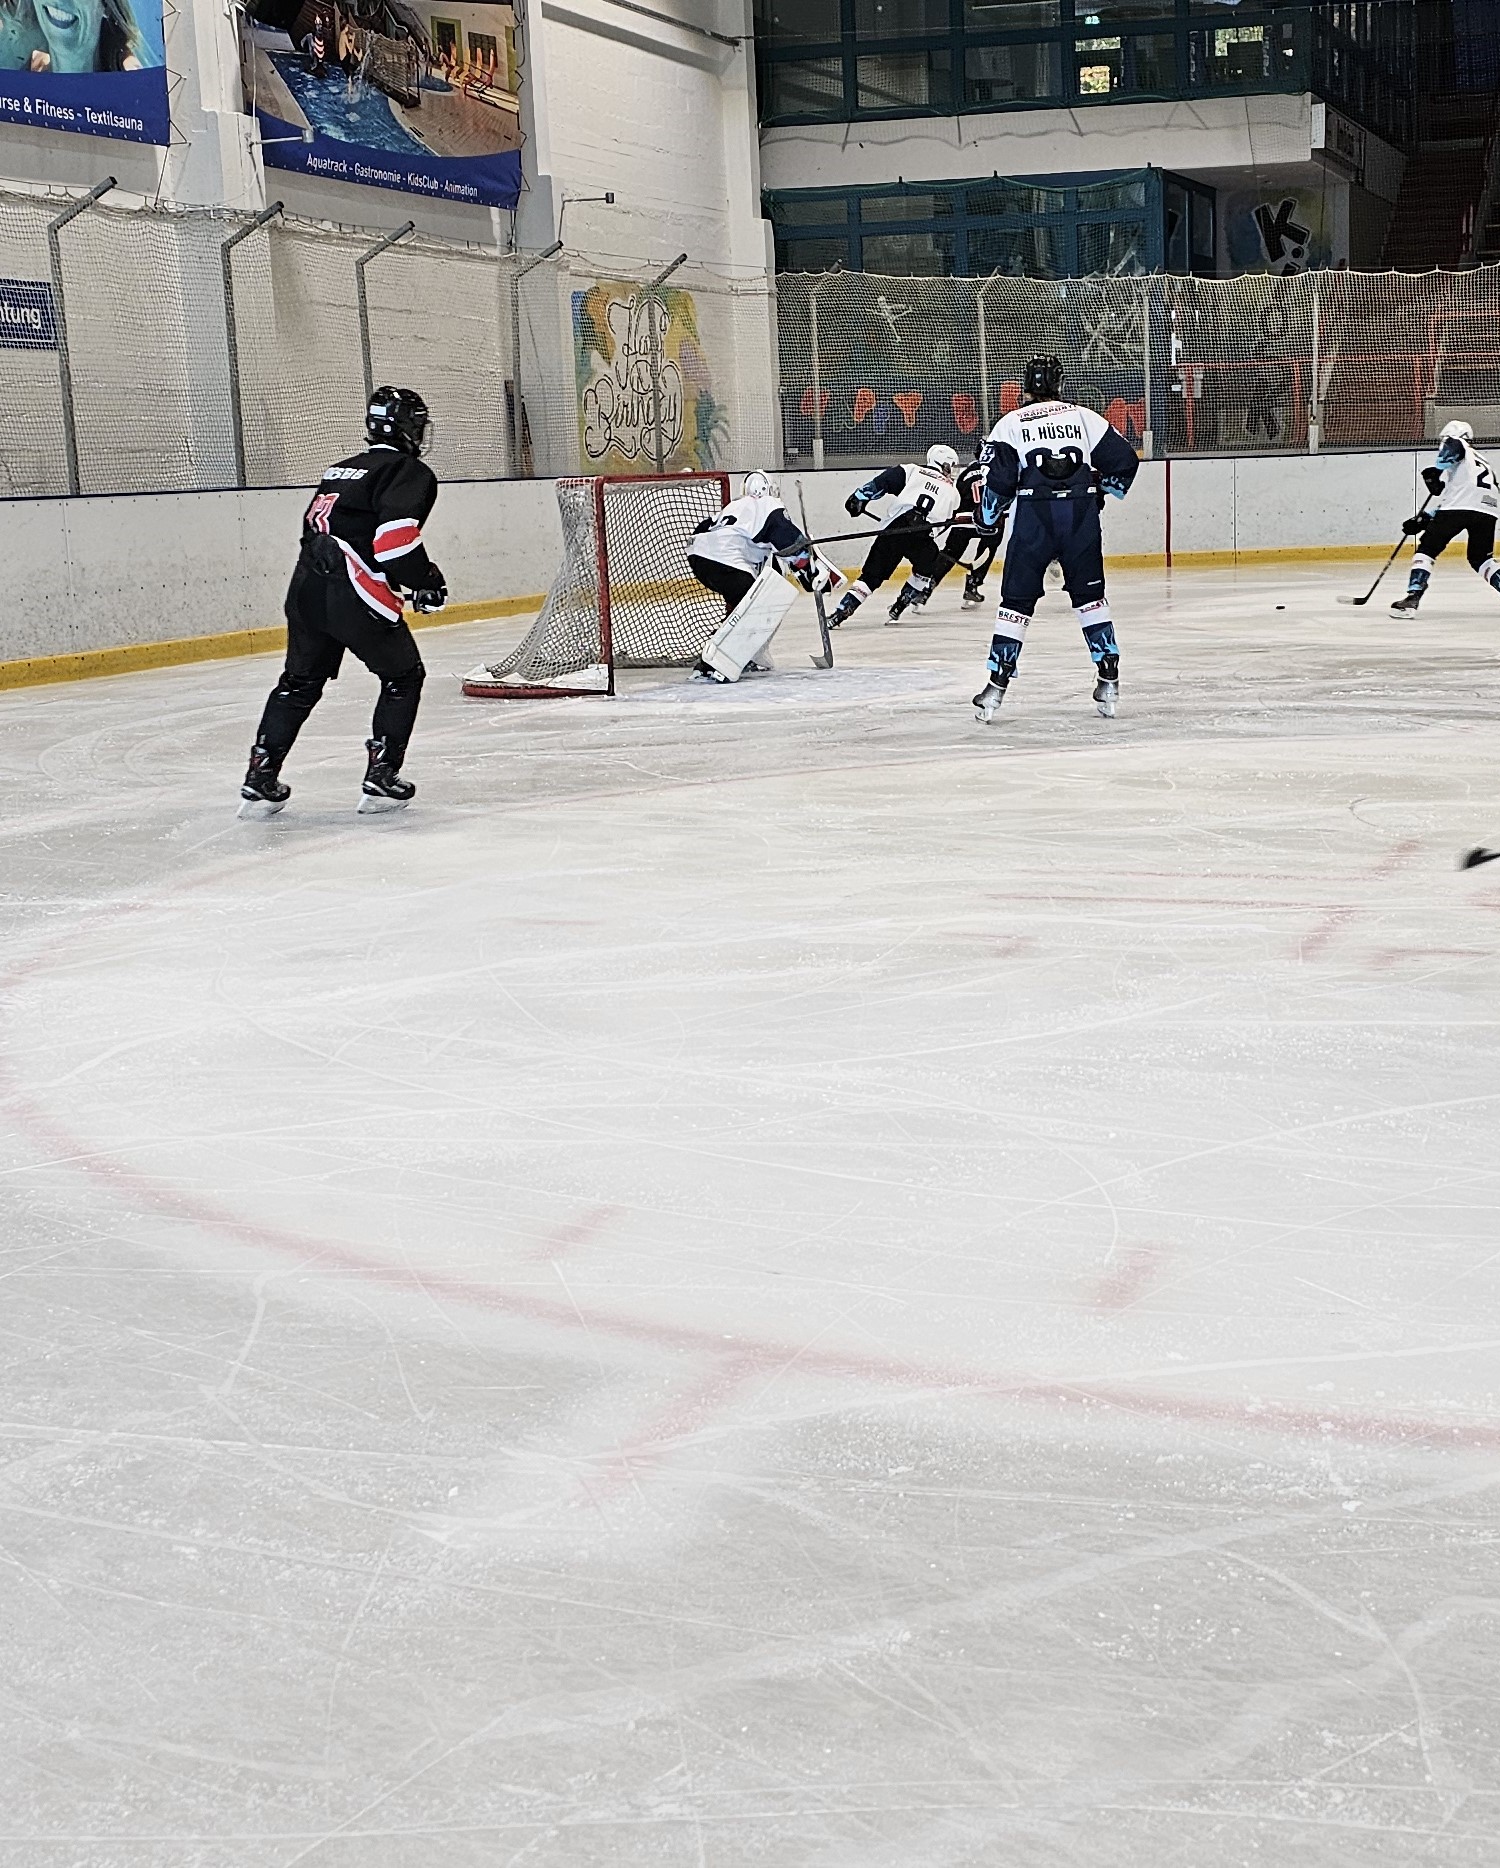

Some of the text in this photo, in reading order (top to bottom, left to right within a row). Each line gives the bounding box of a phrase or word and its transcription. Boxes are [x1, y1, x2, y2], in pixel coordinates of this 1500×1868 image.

[0, 96, 20, 112] rse
[23, 96, 33, 114] &
[35, 98, 74, 120] Fitness
[84, 107, 143, 132] Textilsauna
[306, 153, 348, 174] Aquatrack
[354, 162, 401, 183] Gastronomie
[407, 172, 439, 190] KidsClub
[444, 179, 478, 197] Animation
[1021, 422, 1082, 443] R. HÜSCH
[924, 481, 940, 496] OHL
